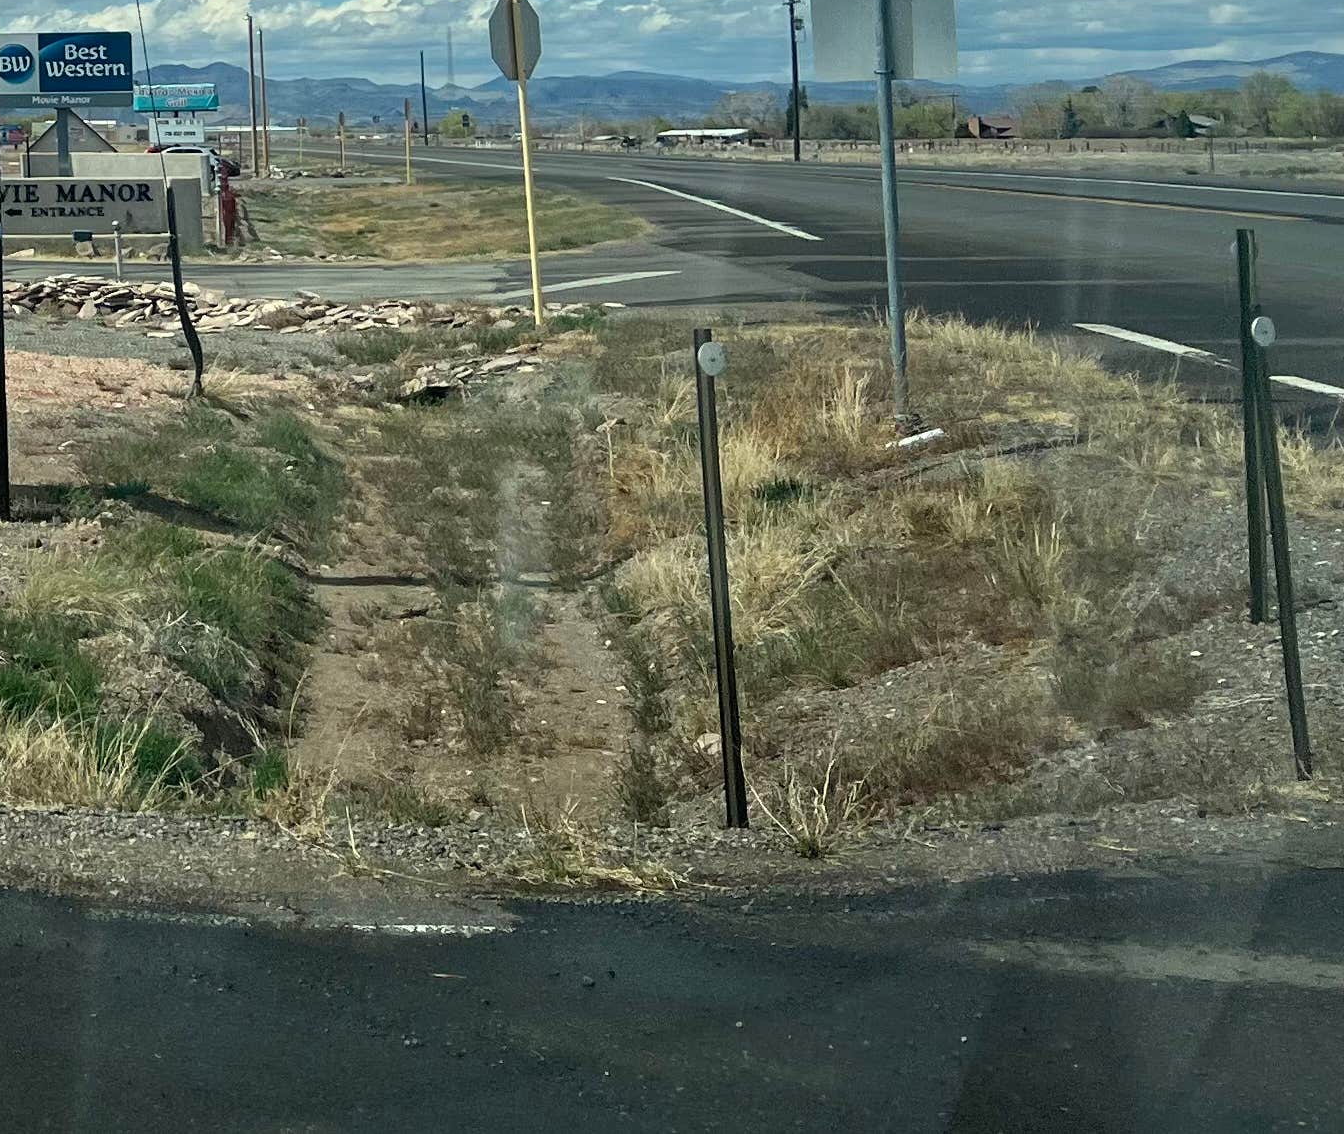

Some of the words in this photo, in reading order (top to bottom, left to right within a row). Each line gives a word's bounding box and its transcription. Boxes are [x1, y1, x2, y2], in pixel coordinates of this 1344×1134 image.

[64, 44, 108, 60] Best
[45, 61, 126, 77] Western
[32, 95, 59, 105] Movie
[61, 95, 92, 104] Manor
[0, 184, 40, 203] VIE
[55, 183, 154, 203] MANOR
[30, 207, 105, 217] ENTRANCE
